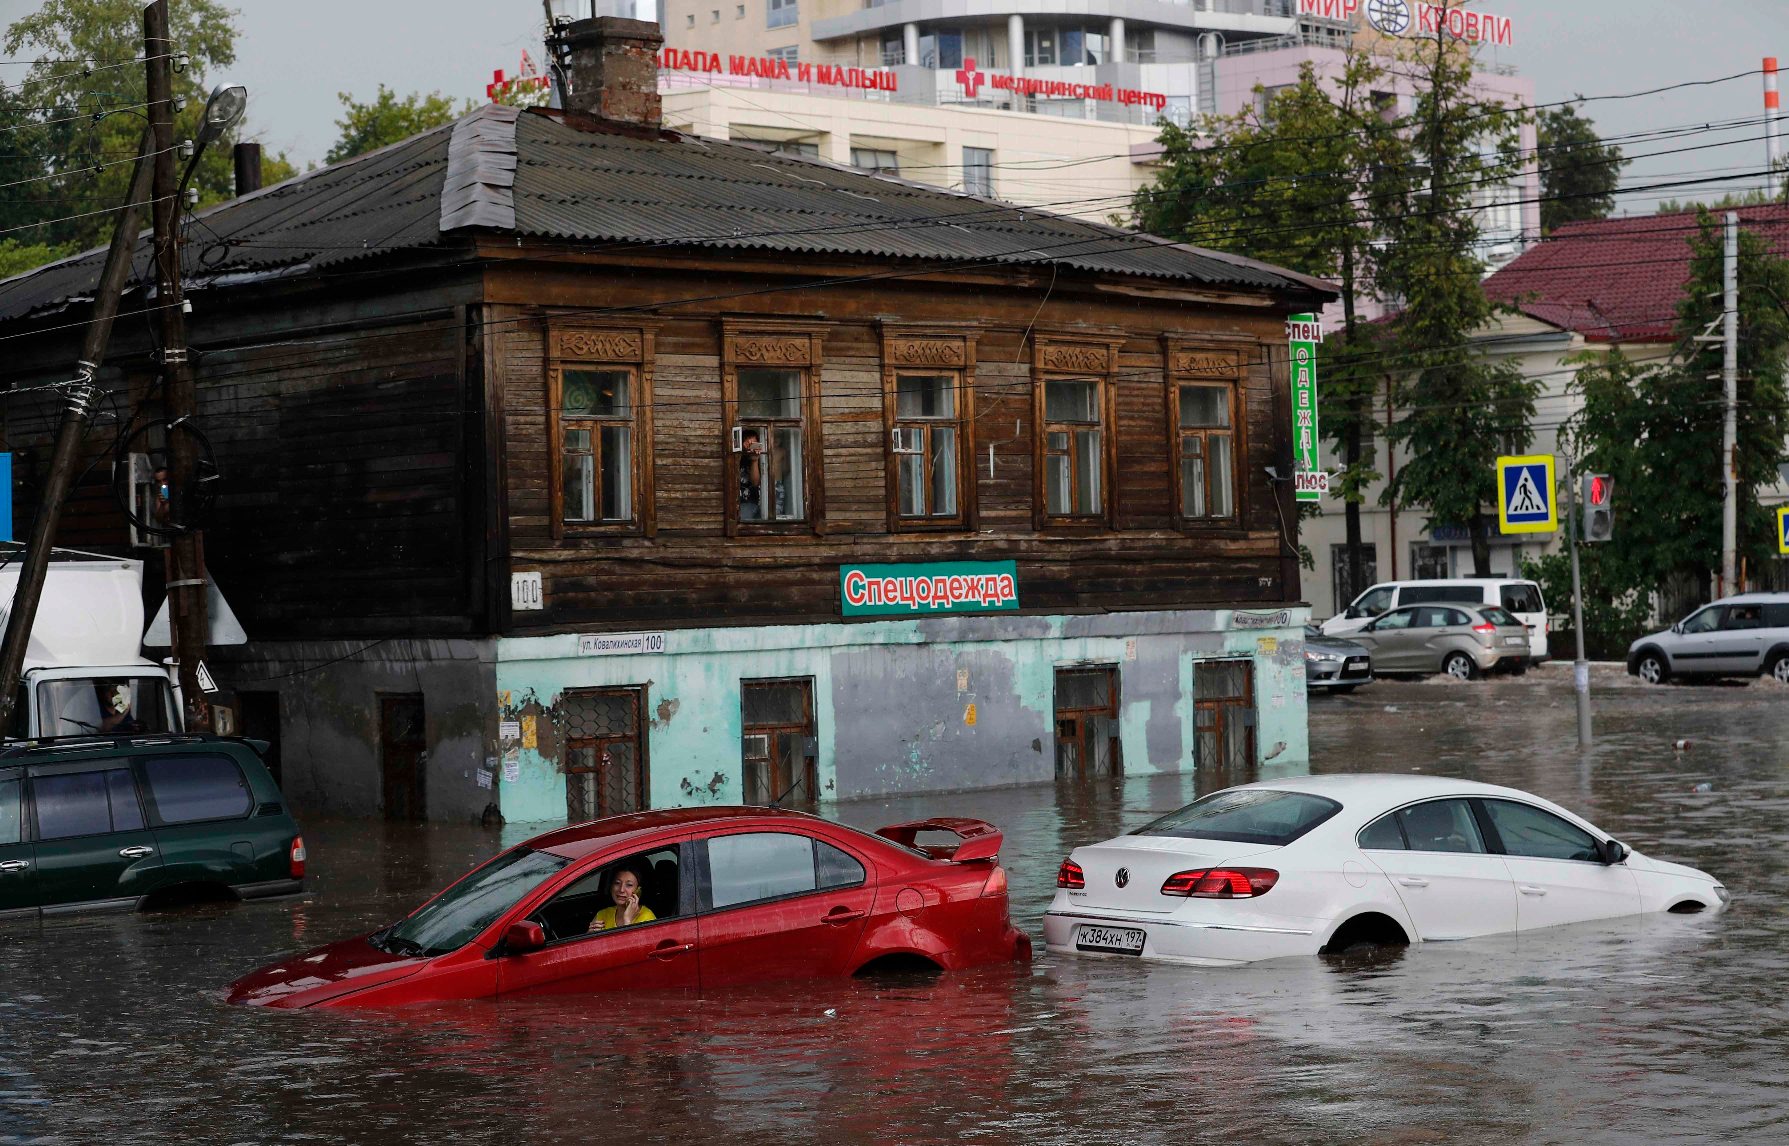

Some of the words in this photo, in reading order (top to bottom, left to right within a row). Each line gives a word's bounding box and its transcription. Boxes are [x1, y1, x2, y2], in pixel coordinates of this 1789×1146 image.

[1300, 0, 1358, 20] МИР
[1418, 3, 1512, 46] КРОВЛИ
[664, 48, 722, 74] ПАПА
[729, 55, 791, 81] МАМА
[797, 62, 811, 83] И
[816, 64, 898, 92] МАЛЫШ
[991, 73, 1114, 101] медицинский
[1117, 87, 1167, 112] центр
[844, 570, 1016, 609] Спецодежда
[645, 635, 662, 650] 100
[1125, 931, 1142, 943] 197
